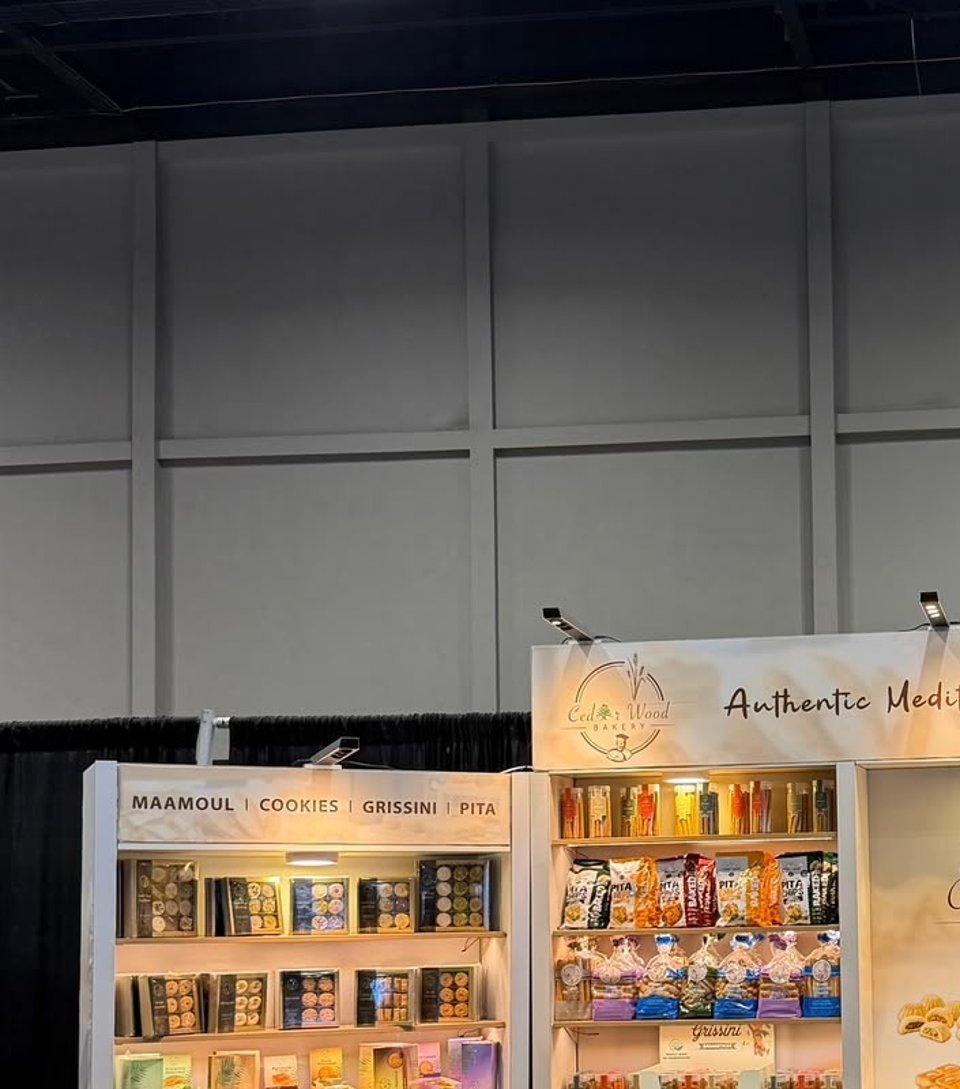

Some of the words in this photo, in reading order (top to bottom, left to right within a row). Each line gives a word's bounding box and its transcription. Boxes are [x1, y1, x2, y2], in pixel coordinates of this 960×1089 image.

[567, 703, 621, 723] Cedr
[627, 701, 671, 721] Wood
[724, 686, 871, 720] Authentic
[593, 722, 646, 732] BAKERY
[131, 795, 235, 811] MAAMOUL
[259, 798, 339, 813] COOKIES
[362, 800, 437, 815] GRISSINI
[460, 802, 496, 815] PITA
[610, 882, 632, 892] PITA
[691, 1024, 742, 1042] Grissini
